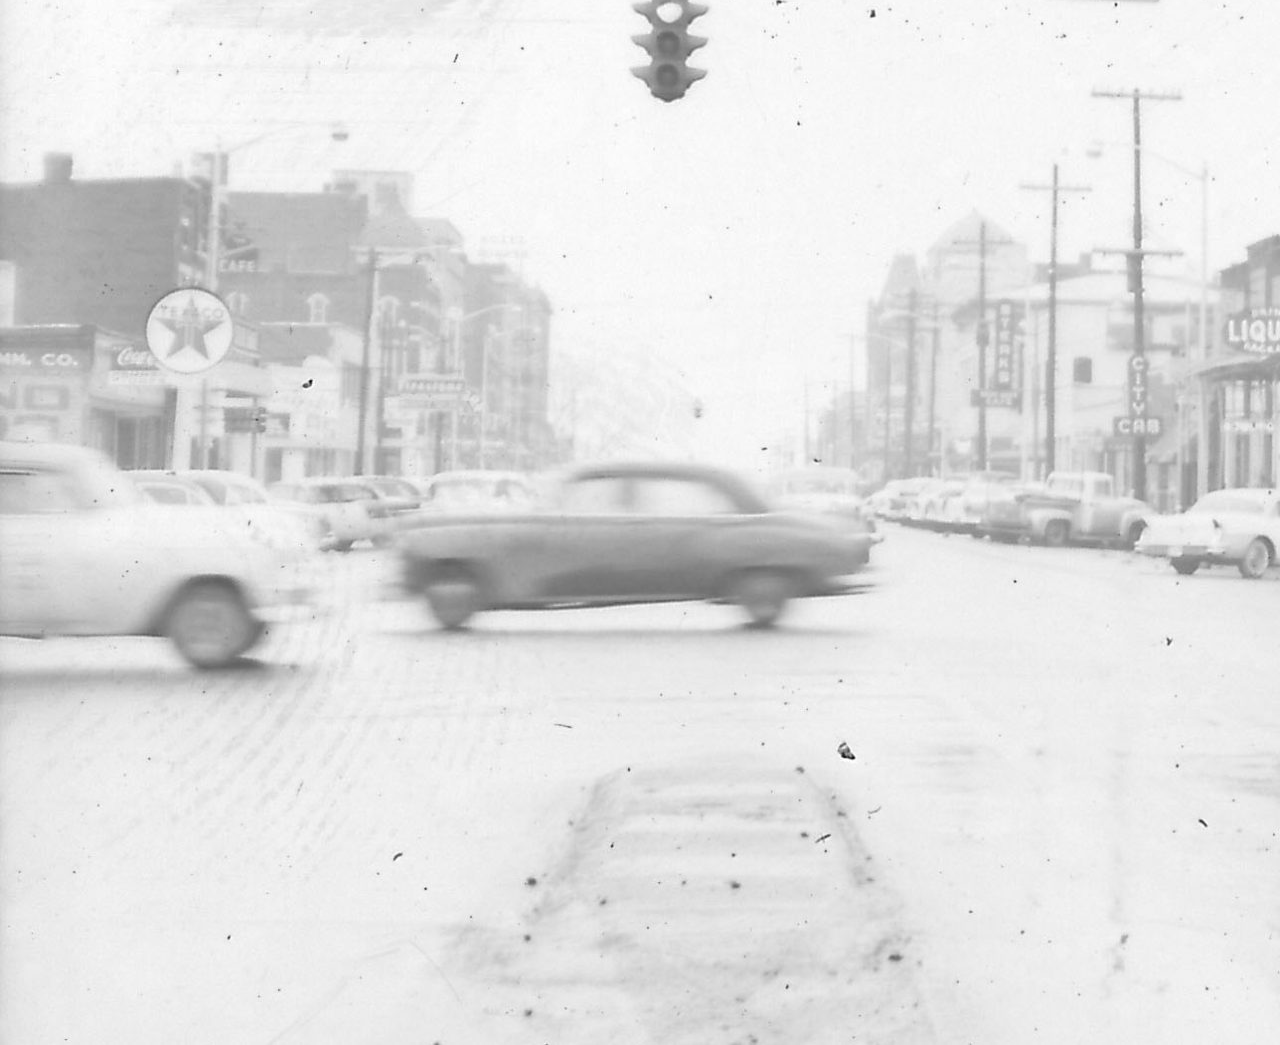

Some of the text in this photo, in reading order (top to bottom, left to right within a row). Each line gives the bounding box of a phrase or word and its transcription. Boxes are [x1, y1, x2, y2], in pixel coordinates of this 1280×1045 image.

[41, 353, 79, 366] CO.
[1131, 356, 1146, 416] CITY
[1117, 418, 1162, 434] CAB
